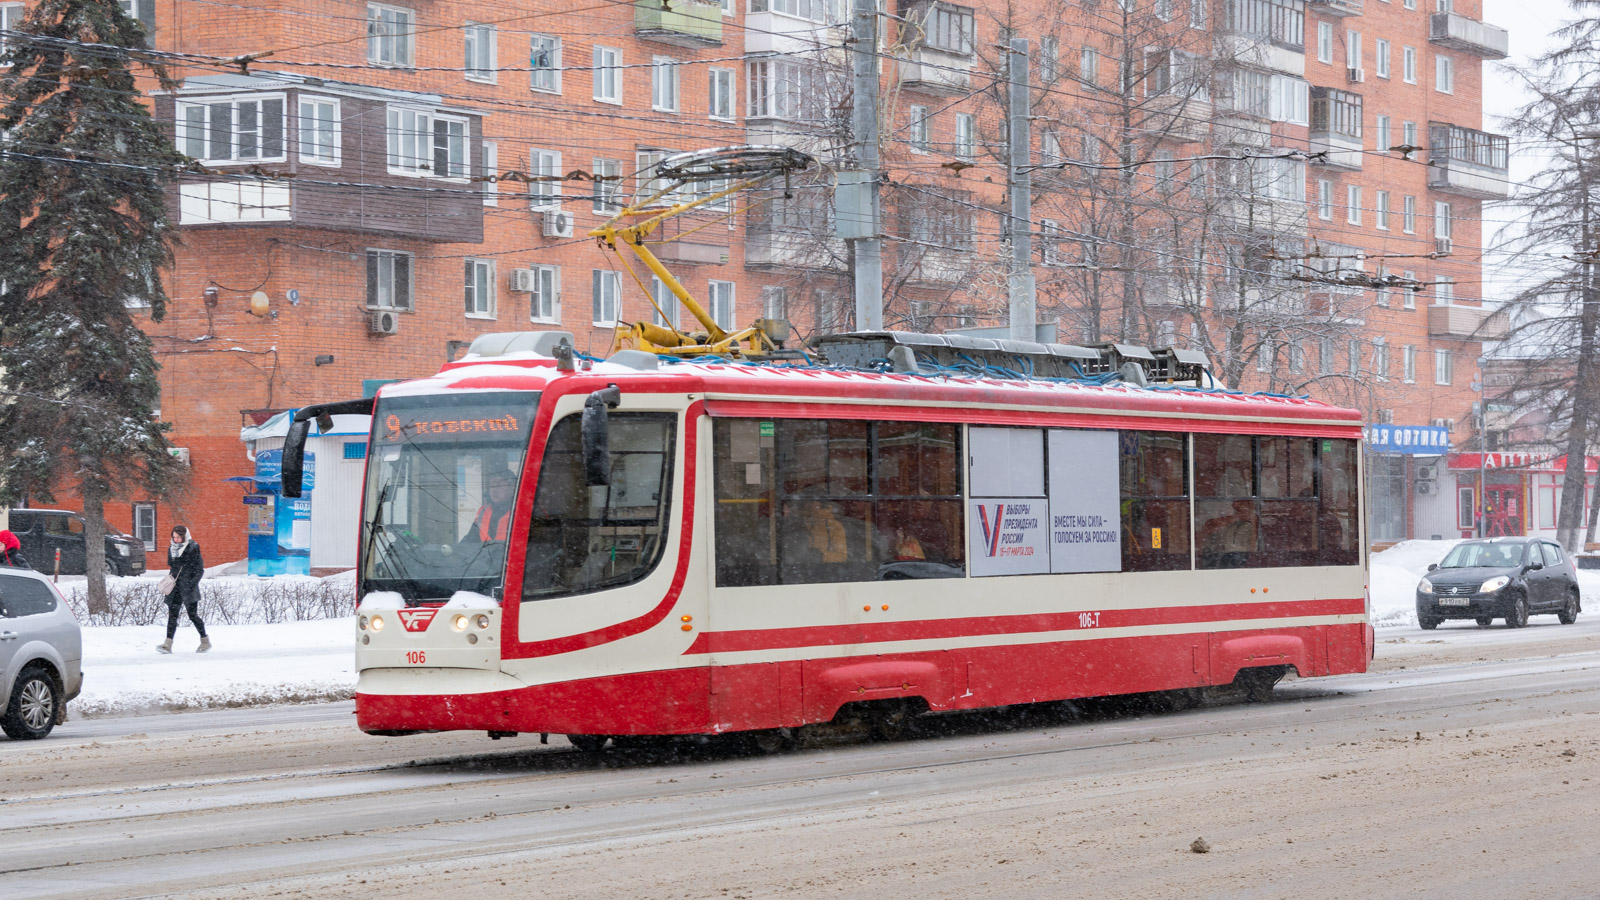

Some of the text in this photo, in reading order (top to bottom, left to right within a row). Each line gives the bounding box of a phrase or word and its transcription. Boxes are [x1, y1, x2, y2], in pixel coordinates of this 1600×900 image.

[385, 413, 519, 442] 9 ковский
[1394, 429, 1447, 446] ОПТИКА
[1006, 504, 1031, 515] ВЫБОРЫ
[1003, 518, 1038, 530] ПРЕЗИДЕНТА
[1054, 515, 1076, 528] ВМЕСТЕ
[1077, 515, 1087, 528] МЫ
[1087, 515, 1103, 528] СИЛА
[1001, 532, 1024, 544] РОССИИ
[1054, 530, 1118, 544] ГОЛОСУЕМ ЗА РОССИЮ!
[405, 651, 426, 664] 106
